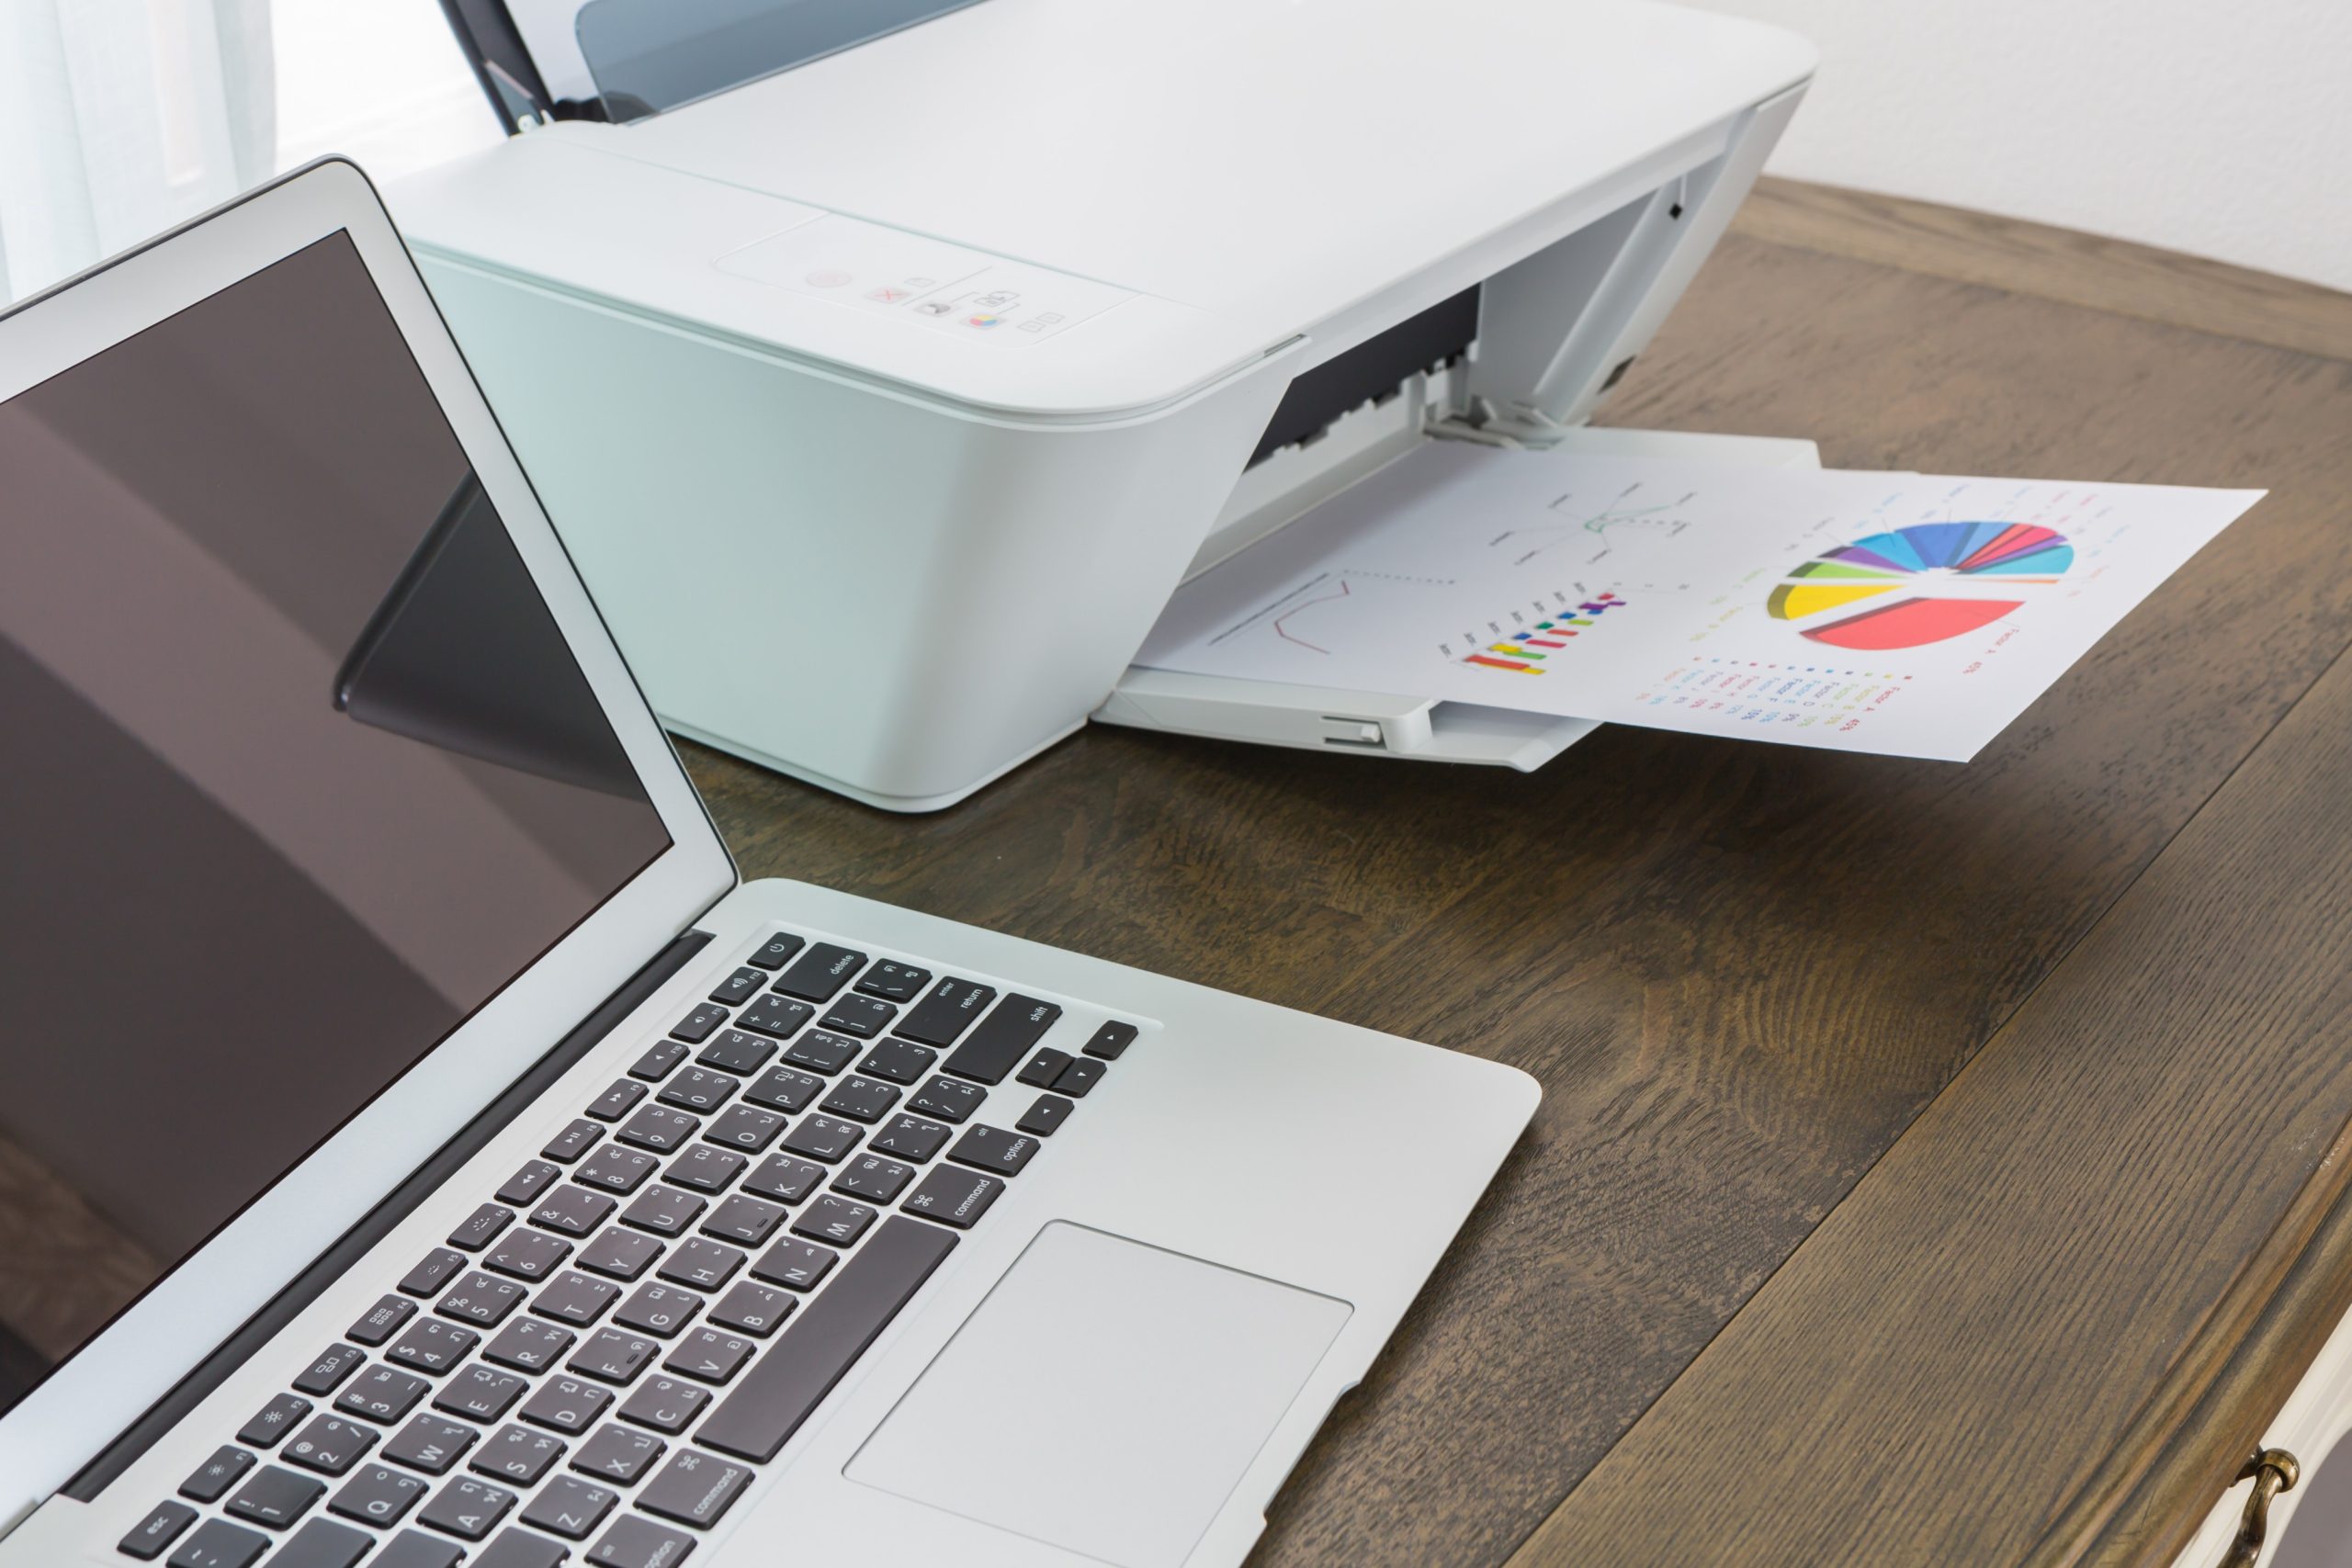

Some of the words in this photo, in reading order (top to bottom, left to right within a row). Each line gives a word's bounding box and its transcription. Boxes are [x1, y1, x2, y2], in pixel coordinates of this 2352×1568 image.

[1995, 628, 2019, 647] Factor
[1776, 678, 1803, 695] Factor
[1813, 682, 1840, 699] Factor
[1874, 686, 1901, 705] Factor
[830, 954, 854, 975] delete
[749, 971, 761, 979] F12
[938, 982, 954, 997] enter
[960, 988, 983, 1009] return
[711, 1007, 722, 1015] F11
[1030, 1006, 1047, 1021] shift
[670, 1045, 683, 1054] F10
[690, 1095, 707, 1103] 0
[775, 1094, 791, 1104] P
[738, 1132, 756, 1142] O
[978, 1127, 989, 1136] alt
[650, 1134, 665, 1143] 9
[1003, 1138, 1027, 1161] option
[542, 1165, 551, 1173] F7
[607, 1175, 624, 1183] 8
[775, 1183, 796, 1194] K
[955, 1179, 990, 1216] command
[562, 1216, 578, 1225] 7
[653, 1213, 673, 1225] U
[737, 1227, 752, 1236] J
[826, 1223, 850, 1236] M
[447, 1254, 458, 1262] F5
[609, 1258, 628, 1268] Y
[520, 1261, 536, 1269] 6
[692, 1269, 714, 1281] H
[785, 1268, 808, 1280] N
[397, 1301, 408, 1309] F4
[470, 1305, 489, 1316] 5
[563, 1303, 583, 1314] T
[650, 1314, 669, 1325] G
[742, 1315, 763, 1325] B
[345, 1349, 356, 1358] F3
[424, 1352, 441, 1362] 4
[516, 1351, 539, 1362] R
[602, 1363, 618, 1374] F
[698, 1359, 719, 1370] V
[290, 1400, 303, 1408] F2
[371, 1402, 390, 1412] 3
[468, 1400, 489, 1411] E
[555, 1410, 576, 1423] D
[655, 1409, 676, 1421] C
[235, 1452, 247, 1461] F1
[318, 1451, 338, 1463] 2
[417, 1444, 444, 1461] W
[506, 1461, 526, 1473] S
[606, 1459, 630, 1473] X
[693, 1468, 738, 1515] command
[261, 1506, 280, 1515] 1
[367, 1500, 391, 1514] Q
[146, 1517, 168, 1534] esc
[458, 1516, 480, 1528] A
[557, 1513, 582, 1528] Z
